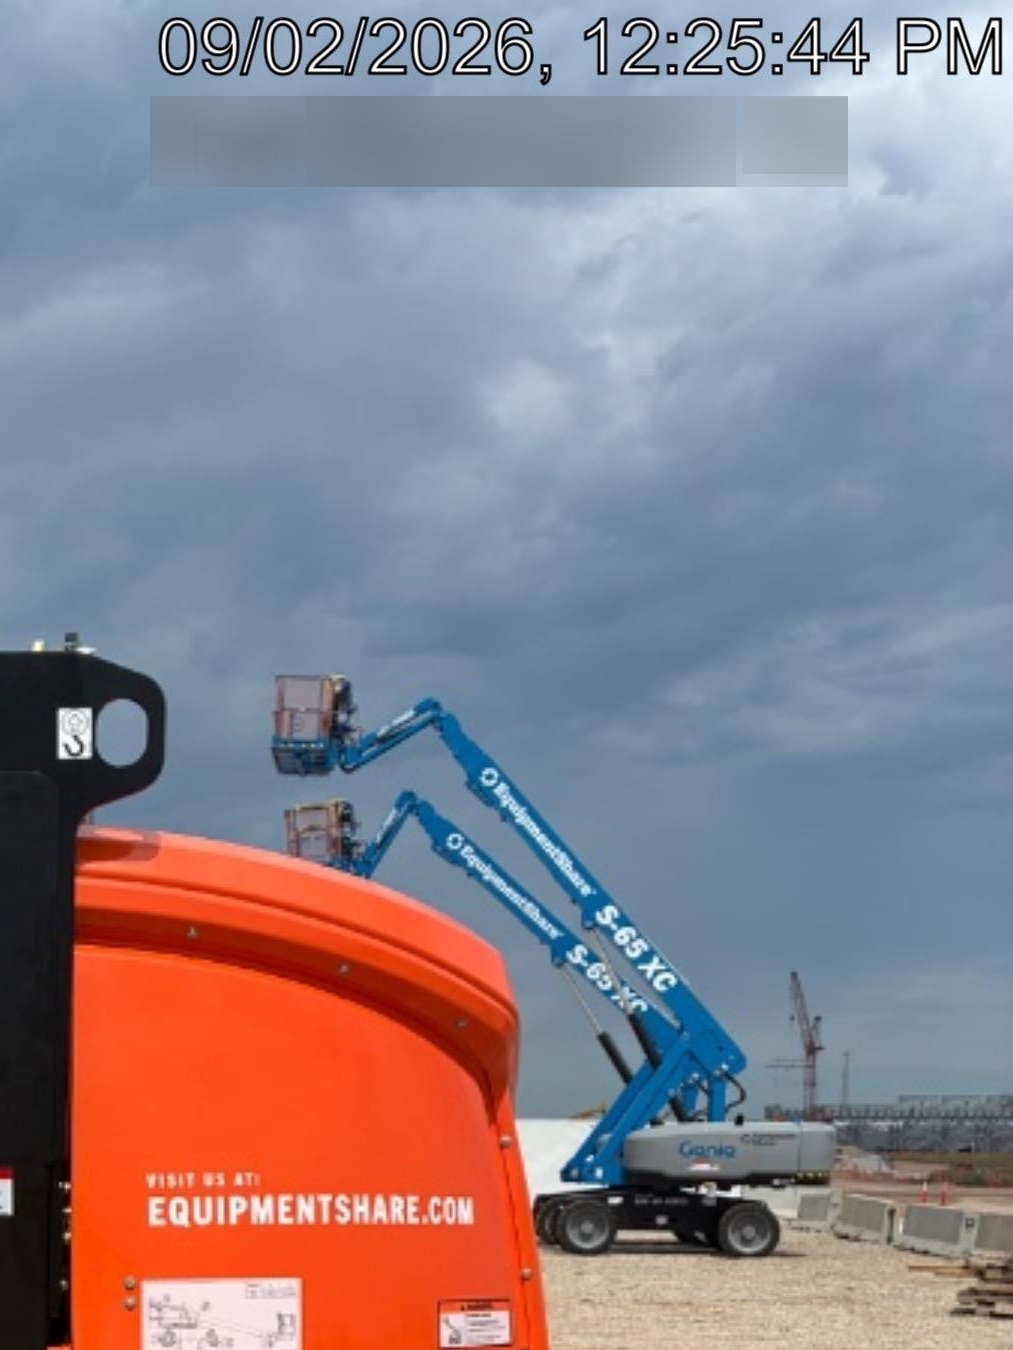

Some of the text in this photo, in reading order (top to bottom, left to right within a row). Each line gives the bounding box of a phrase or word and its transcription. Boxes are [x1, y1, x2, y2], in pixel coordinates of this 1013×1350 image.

[493, 782, 593, 896] EquipmentShare
[460, 846, 561, 939] EquipmentShare
[595, 904, 678, 992] S-65 XC
[146, 1172, 195, 1188] VISIT
[203, 1172, 225, 1187] US
[148, 1194, 475, 1228] EQUIPMENTSHARE.COM
